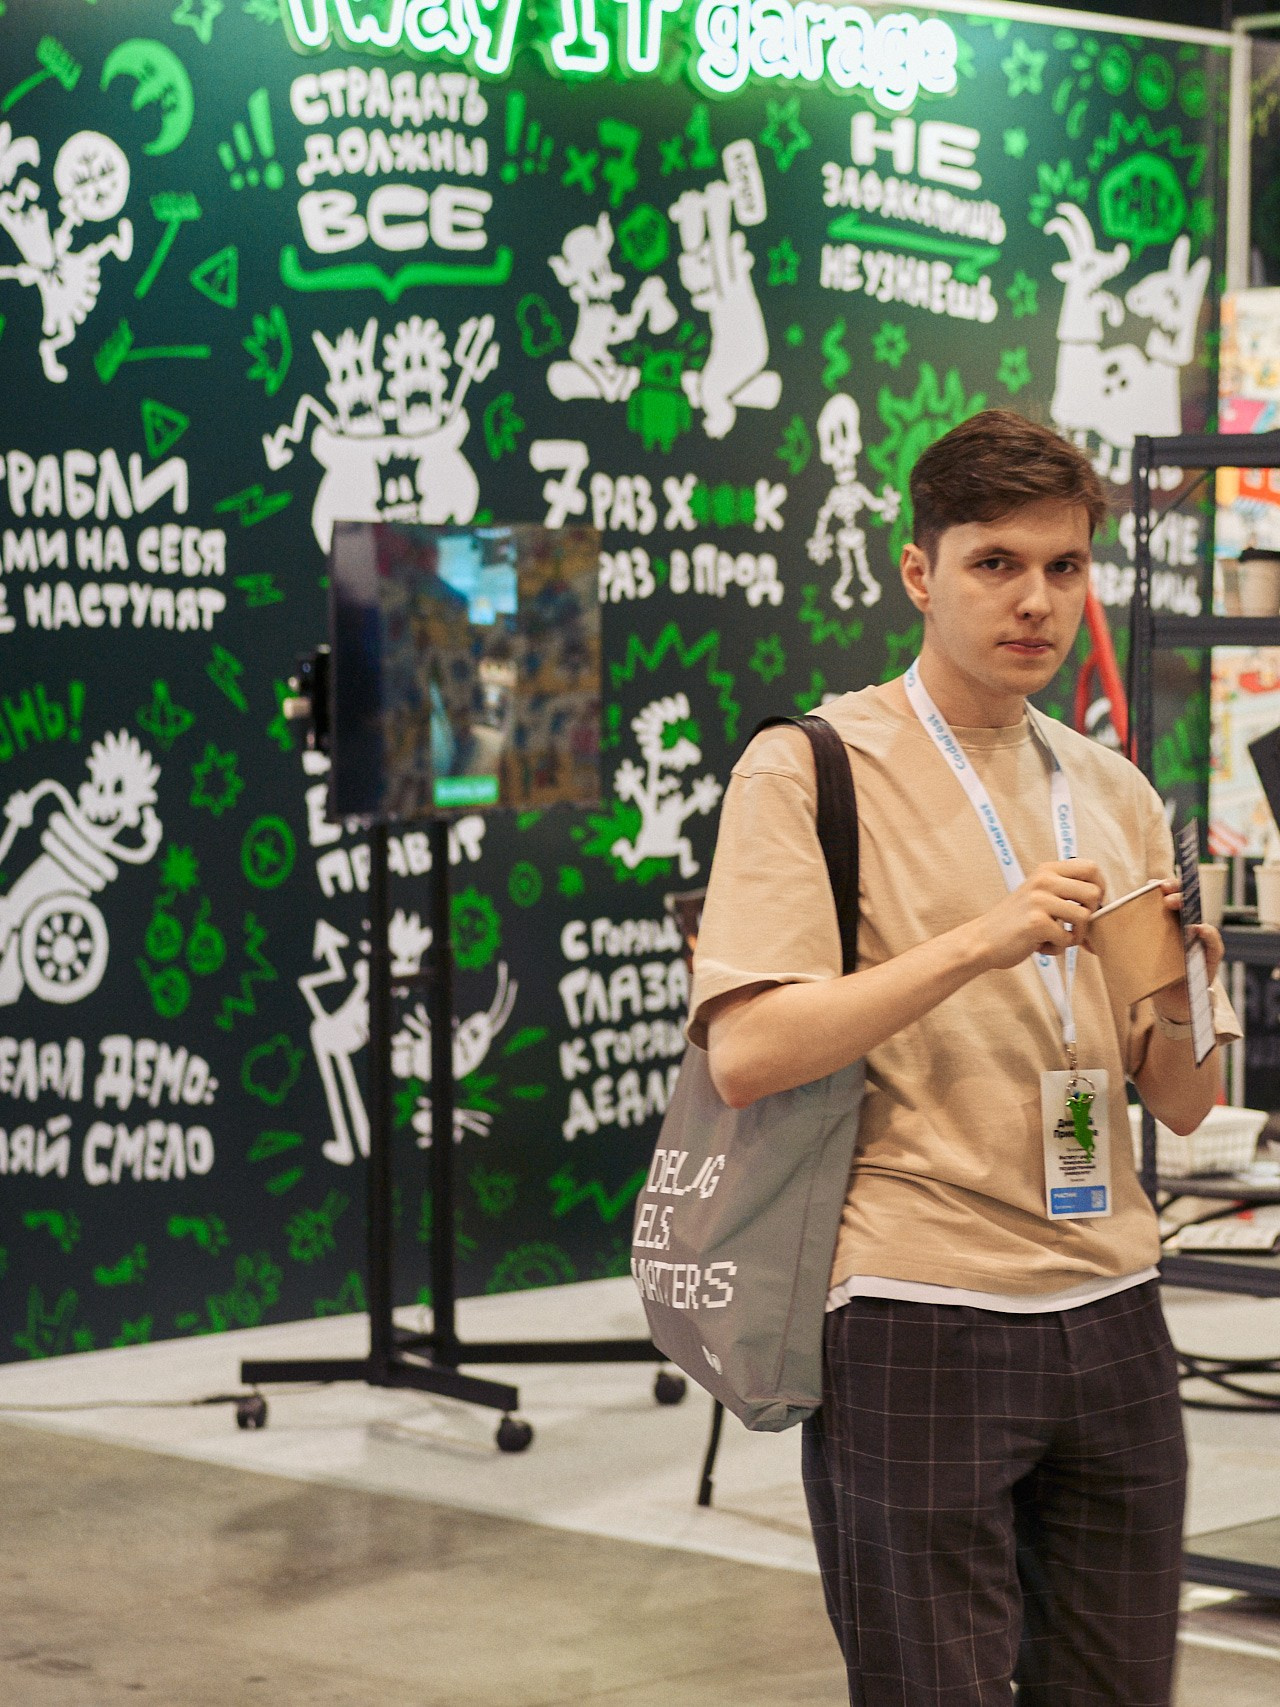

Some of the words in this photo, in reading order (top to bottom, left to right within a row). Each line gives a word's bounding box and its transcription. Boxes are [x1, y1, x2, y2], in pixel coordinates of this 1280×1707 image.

[549, 0, 686, 73] IT
[694, 0, 960, 112] garage
[290, 66, 489, 127] СТРАДАТЬ
[297, 127, 489, 186] ДОЛЖНЫ
[851, 111, 982, 191] НЕ
[298, 184, 493, 253] ВСЕ
[862, 249, 998, 324] УЗНАЕШЬ
[0, 447, 190, 521] РАБЛИ
[529, 439, 589, 530] 7
[590, 472, 657, 535] РАЗ
[0, 527, 69, 573] МИ
[75, 525, 129, 573] НА
[137, 523, 227, 577] СЕБЯ
[669, 549, 690, 594] В
[692, 543, 785, 607] ПРОД
[23, 581, 227, 631] НАСТУПЯТ
[927, 713, 966, 770] CodeFest
[980, 803, 1013, 866] CodeFest
[1057, 803, 1075, 860] CodeFes
[560, 919, 589, 962] С
[558, 957, 690, 1029] ГЛАЗА
[0, 1036, 85, 1102] ЕЛАЛ
[94, 1033, 219, 1112] ДЕМО:
[559, 1036, 591, 1081] К
[82, 1119, 215, 1187] СМЕЛО
